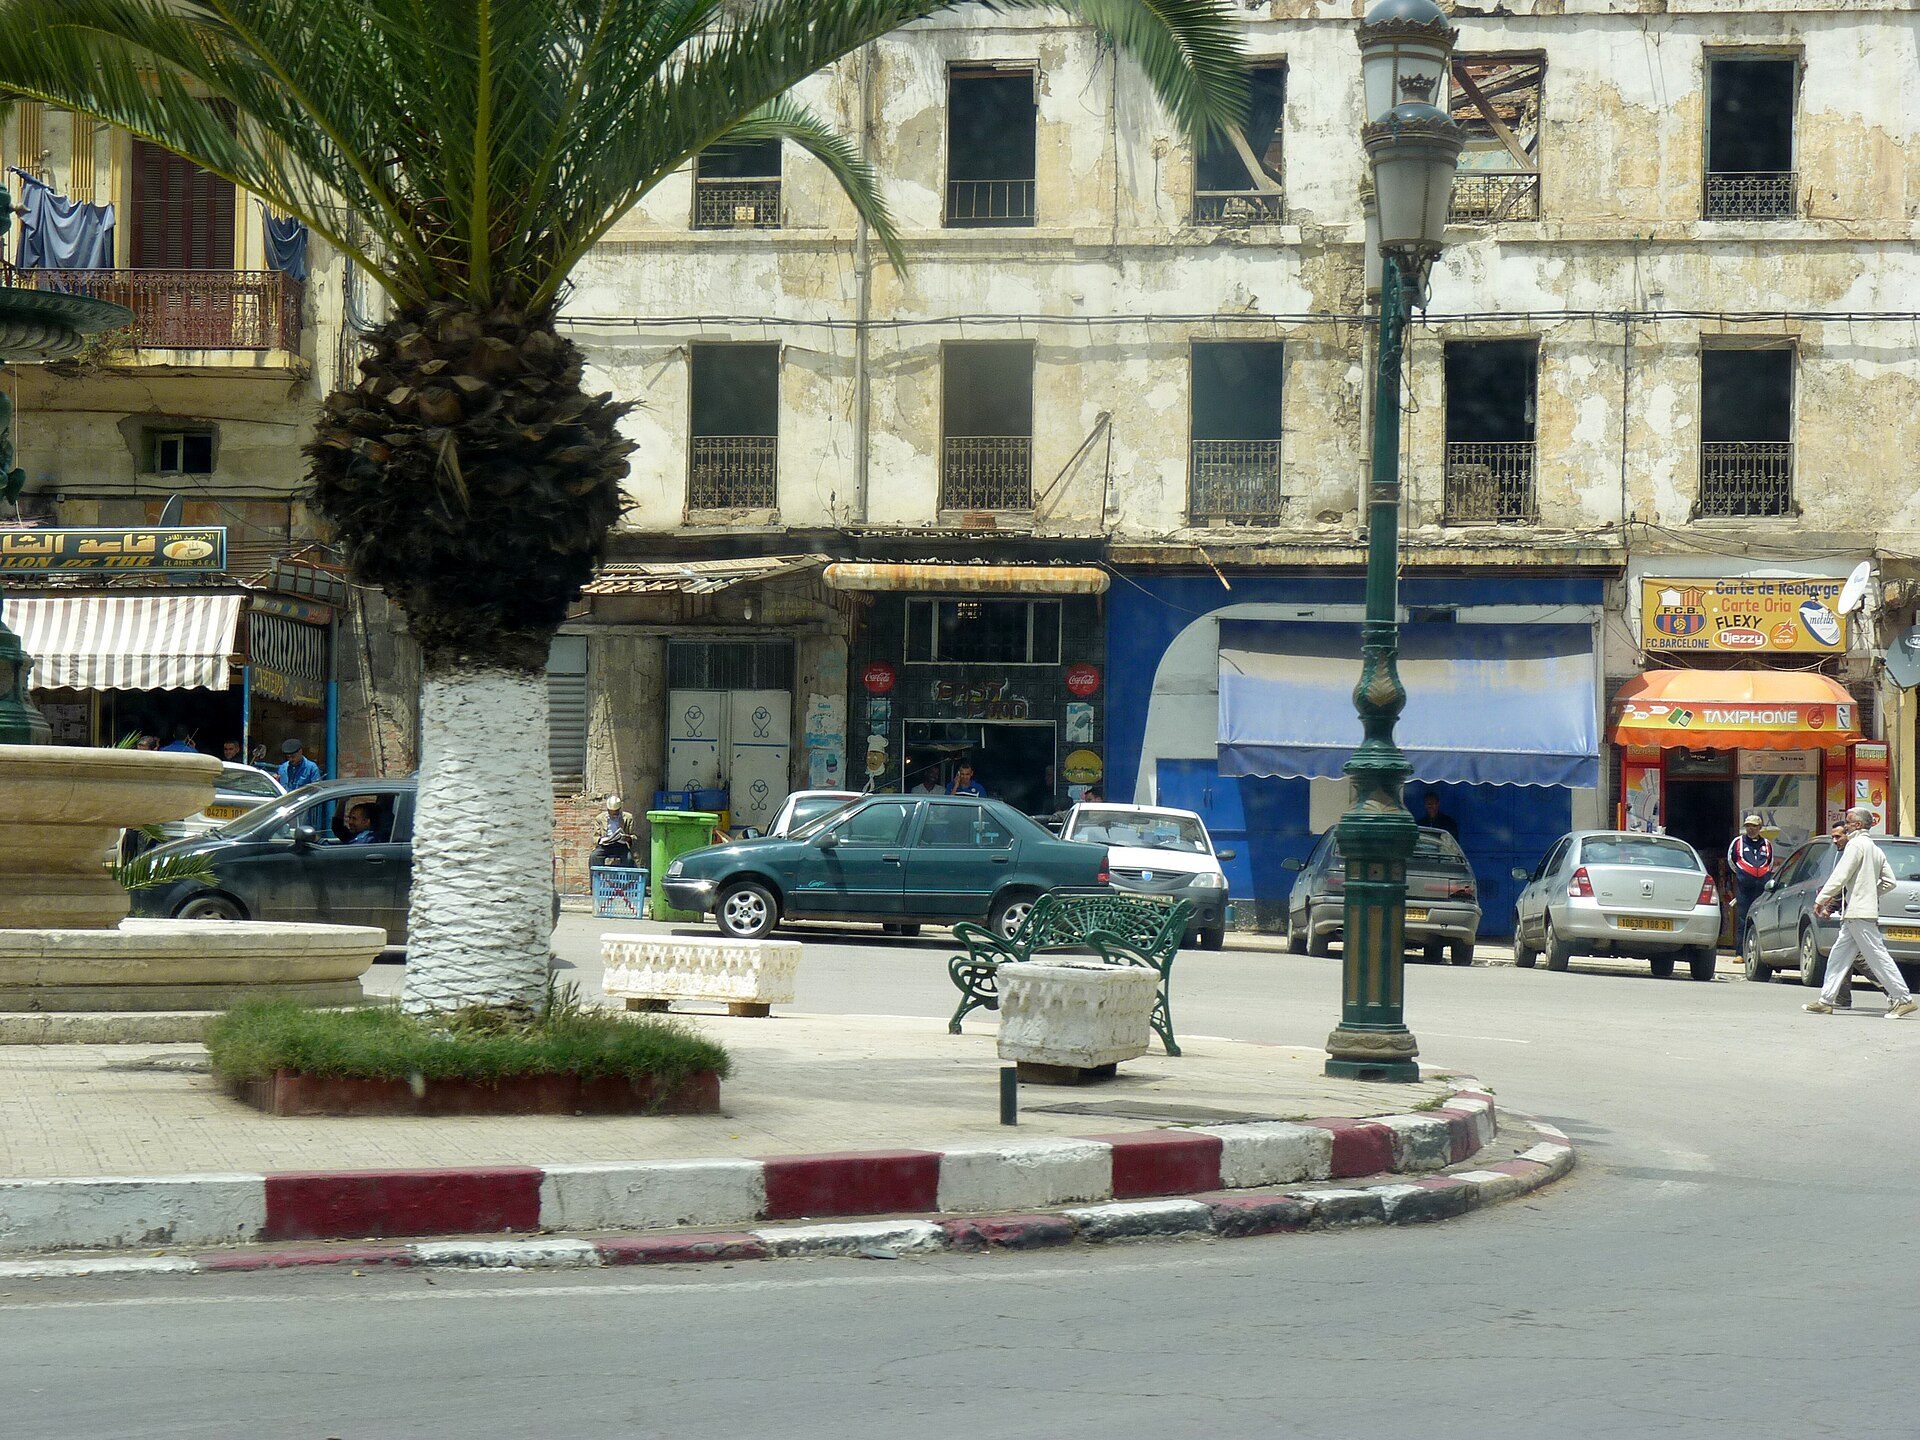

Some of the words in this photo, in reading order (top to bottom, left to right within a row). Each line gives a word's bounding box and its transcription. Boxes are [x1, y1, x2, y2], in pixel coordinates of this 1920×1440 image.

[1715, 581, 1754, 595] Carte
[1757, 581, 1774, 595] de
[1778, 582, 1839, 599] Recharge
[1663, 606, 1699, 614] F.C.B.
[1721, 598, 1760, 612] Carte
[1715, 614, 1762, 630] FLEXY
[1720, 632, 1763, 646] Djezzy
[1703, 709, 1798, 724] TAXIPHONE
